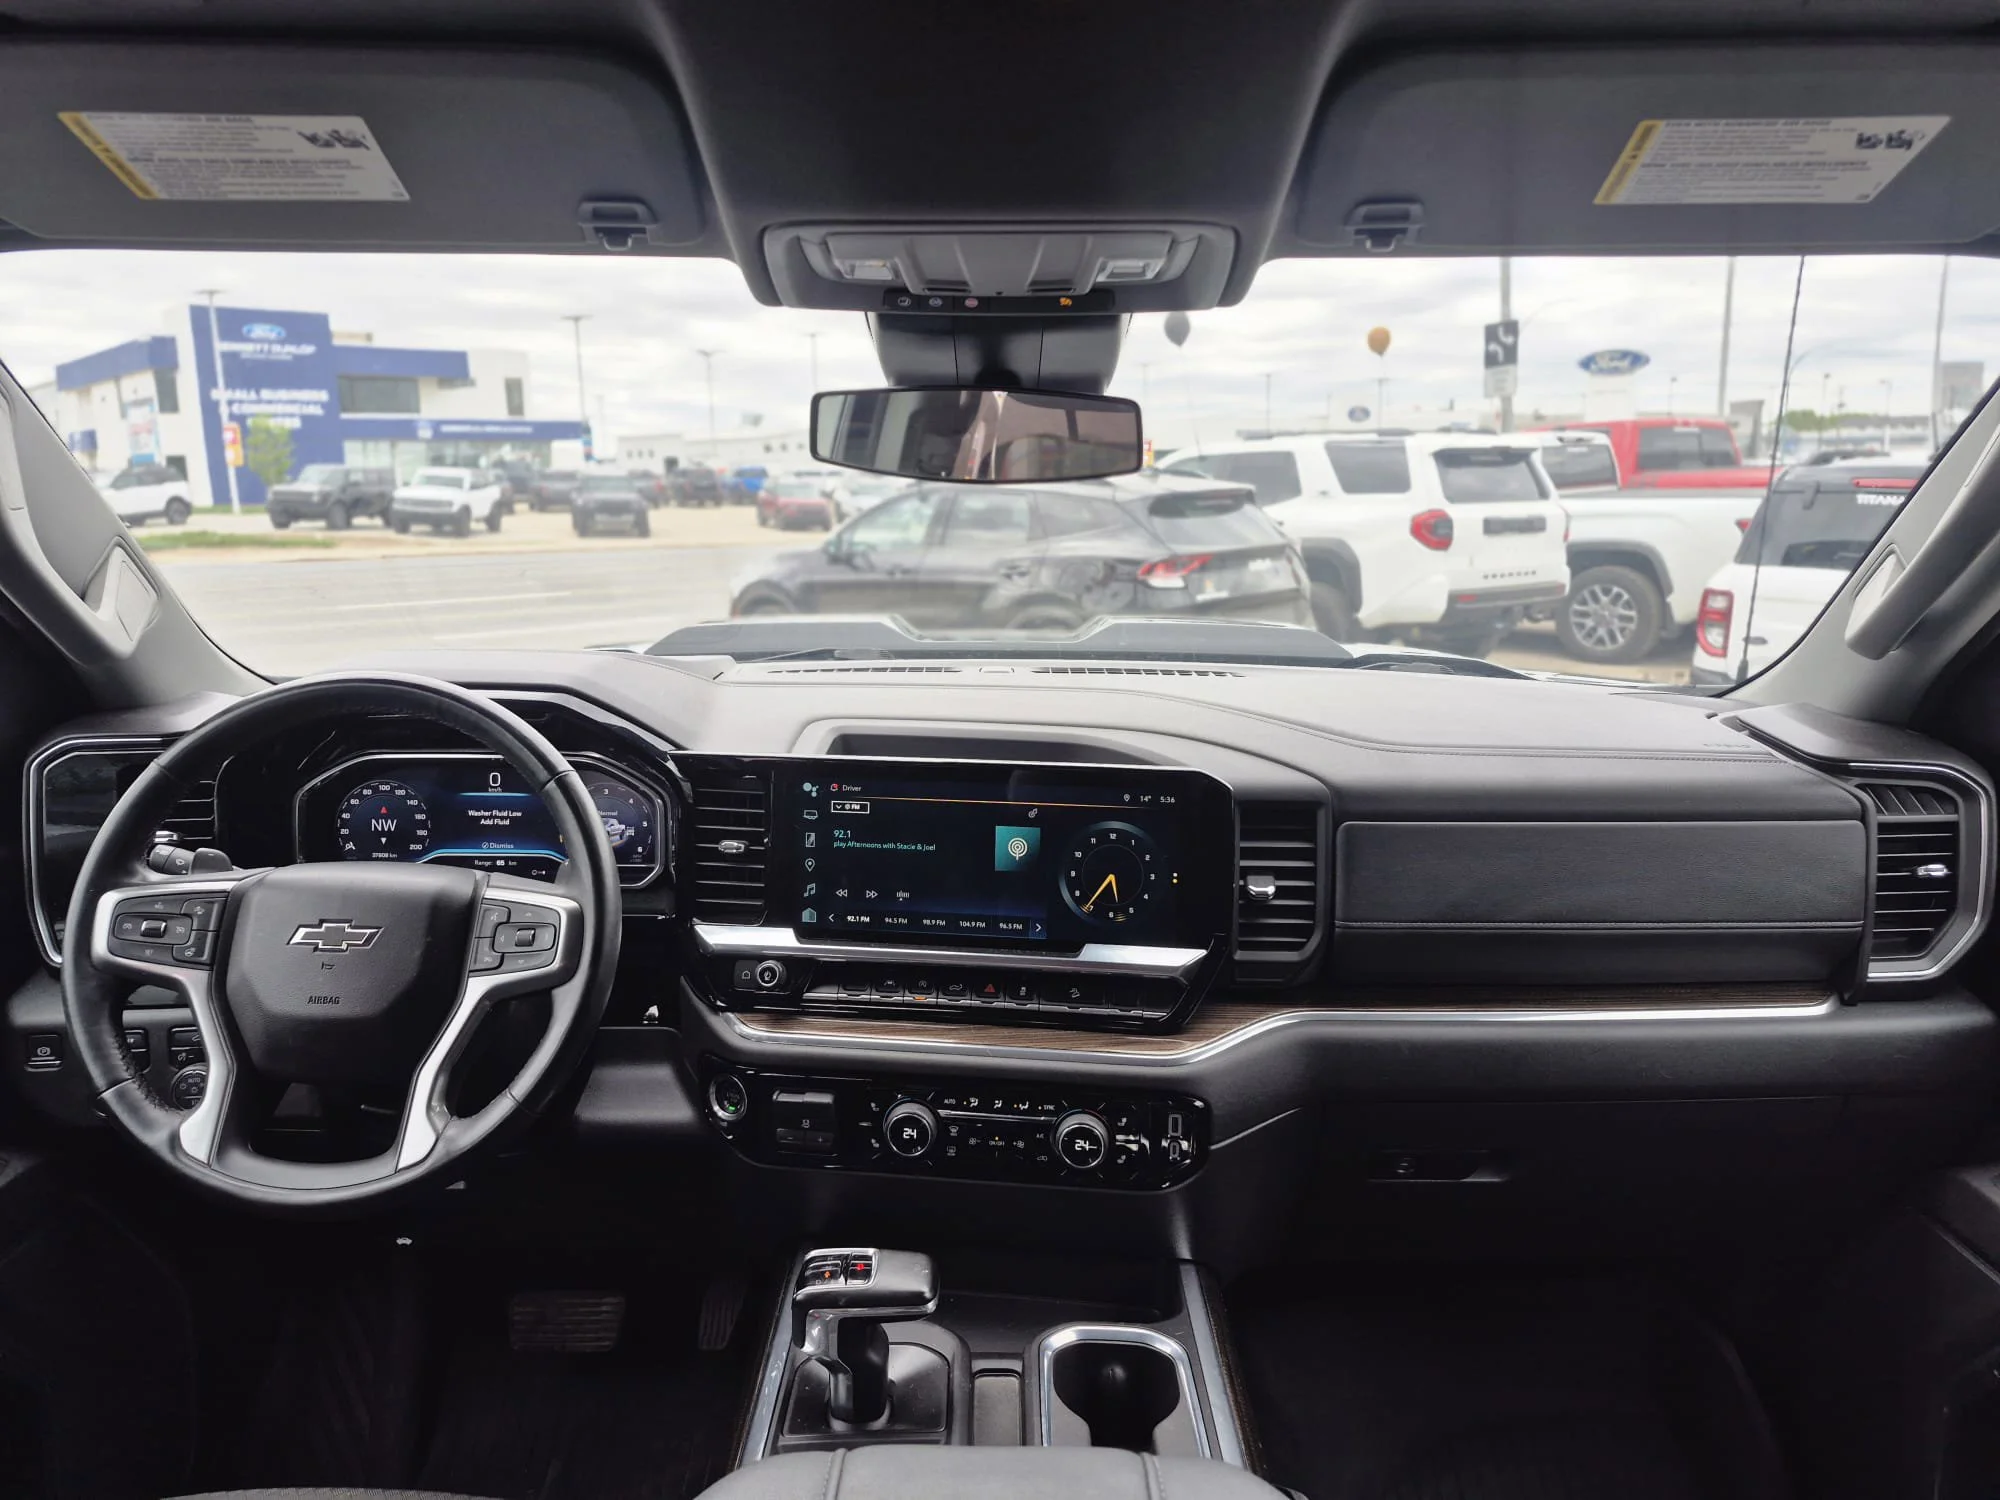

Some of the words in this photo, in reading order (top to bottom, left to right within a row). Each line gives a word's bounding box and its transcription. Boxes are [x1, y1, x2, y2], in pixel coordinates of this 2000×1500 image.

[490, 772, 501, 786] 0
[371, 819, 397, 831] NW
[834, 830, 851, 838] 92.1
[847, 840, 881, 849] Afternoons
[307, 996, 340, 1004] AIRBAG
[903, 1128, 917, 1139] 24
[1074, 1140, 1090, 1151] 24
